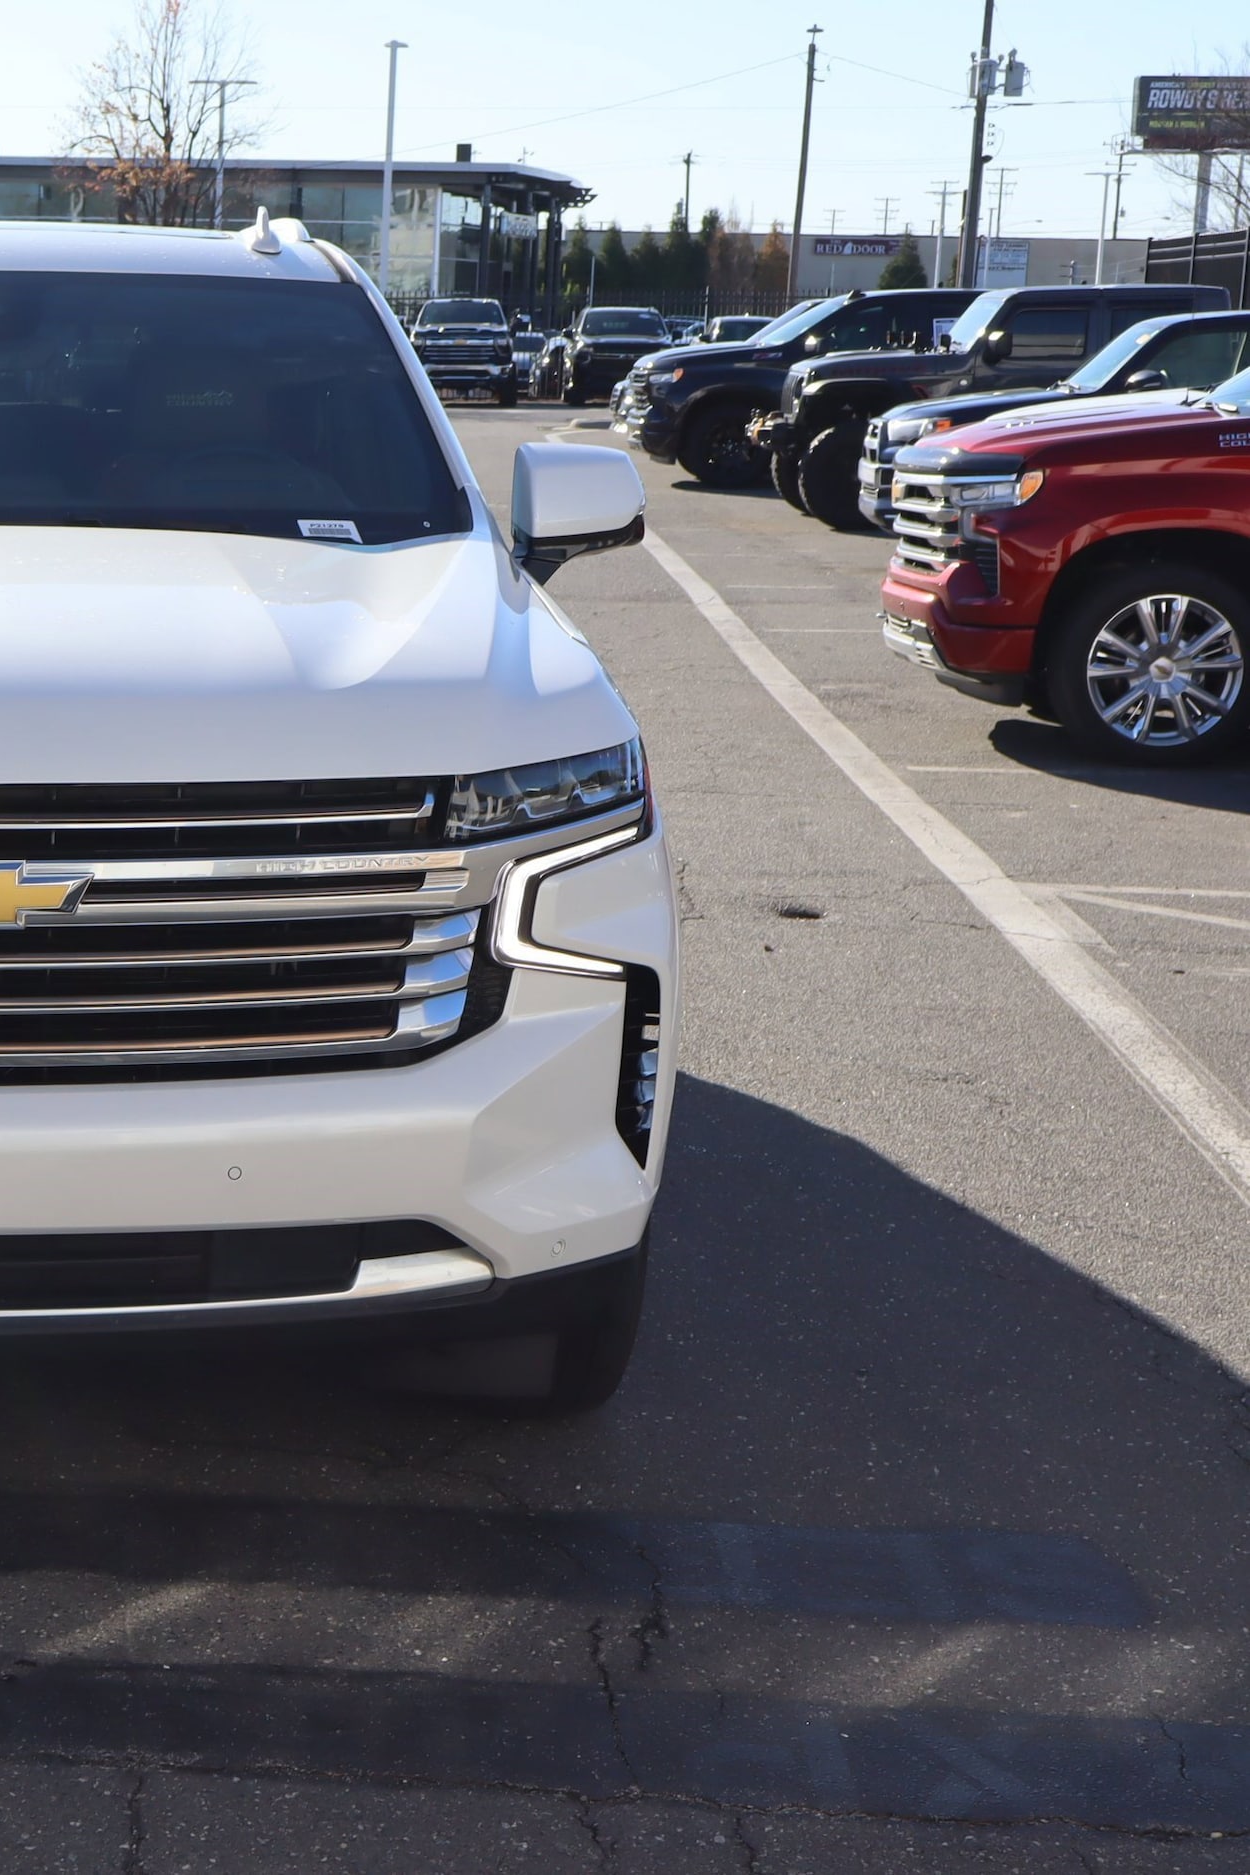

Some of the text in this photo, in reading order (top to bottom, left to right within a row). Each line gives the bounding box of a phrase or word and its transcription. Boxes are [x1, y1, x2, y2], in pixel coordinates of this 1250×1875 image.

[1147, 89, 1207, 109] ROWDY
[816, 243, 842, 254] RED
[853, 244, 886, 255] DOOR
[256, 855, 431, 873] HIGH COUNTRY
